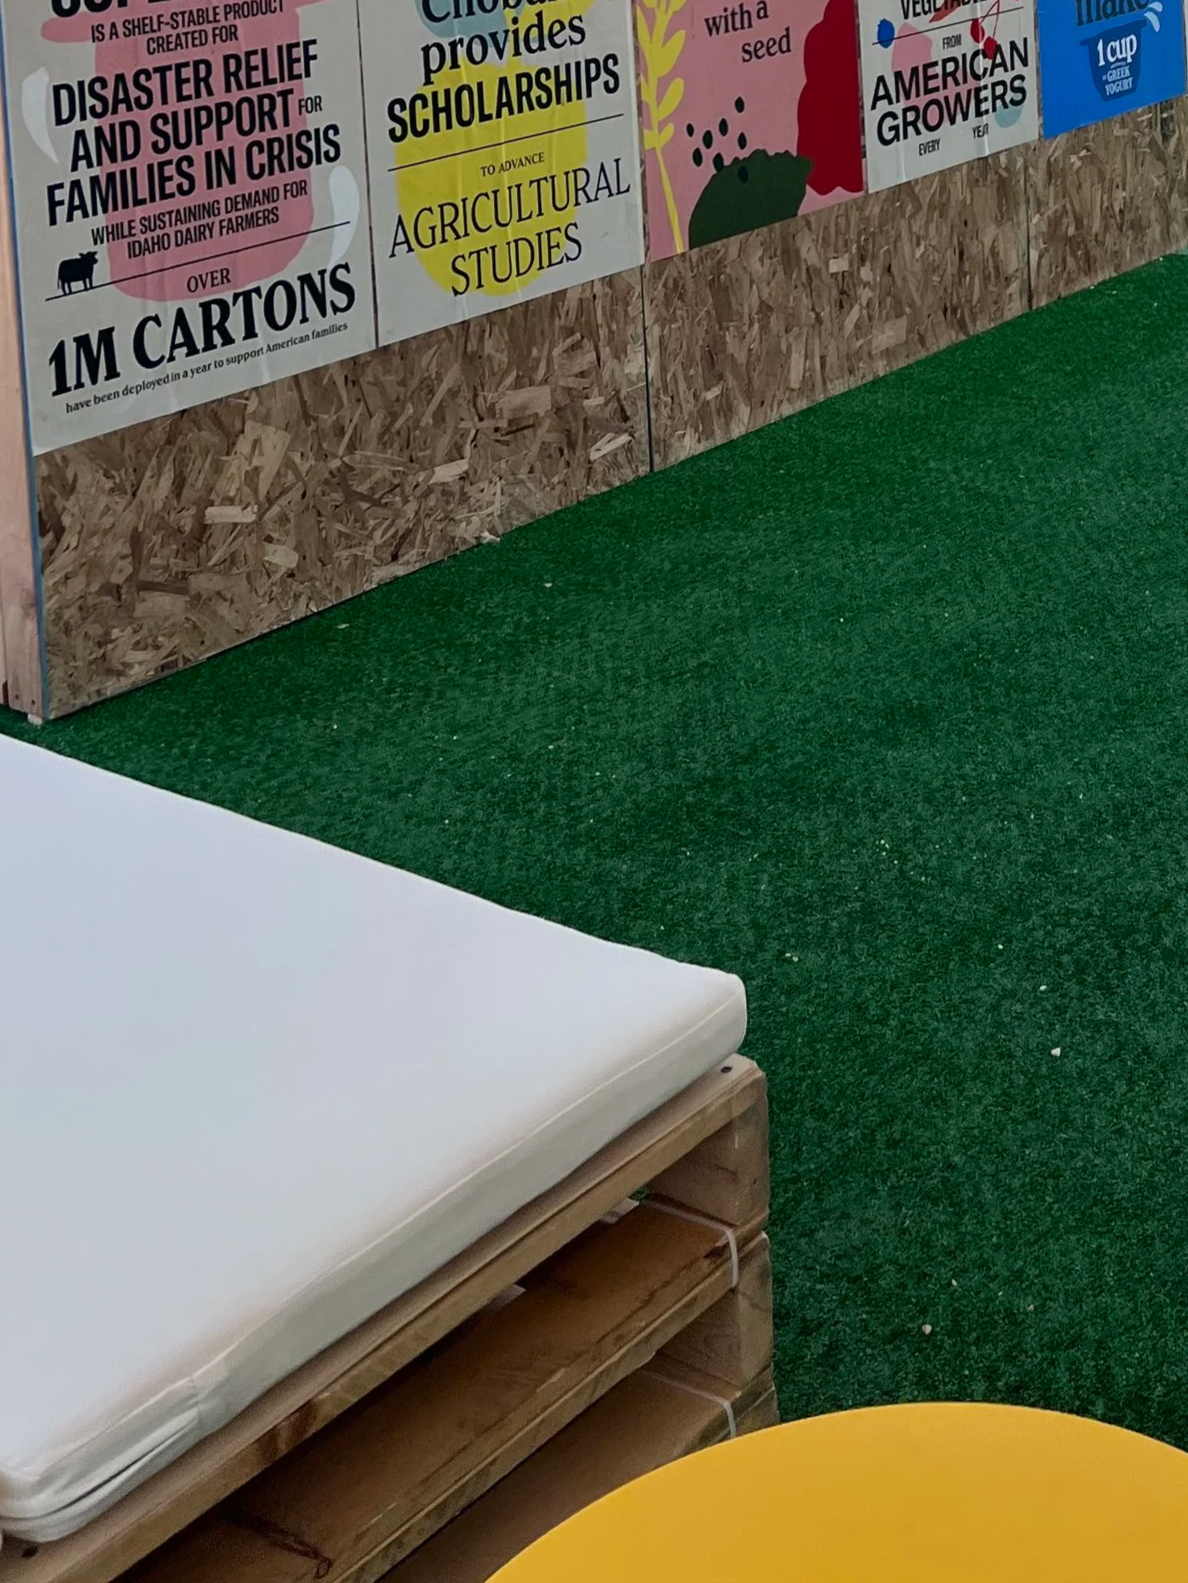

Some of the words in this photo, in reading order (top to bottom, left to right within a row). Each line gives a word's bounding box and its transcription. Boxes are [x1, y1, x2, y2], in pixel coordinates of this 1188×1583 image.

[741, 27, 791, 63] seed
[1097, 39, 1105, 66] 1
[1107, 34, 1137, 63] cup
[52, 58, 214, 127] DISASTER
[223, 39, 318, 93] RELIEF
[1105, 77, 1133, 95] YOGURT
[1107, 66, 1130, 82] GREEK
[387, 53, 620, 143] SCHOLARSHIPS
[480, 164, 495, 177] TO
[498, 152, 545, 174] ADVANCE
[186, 268, 231, 294] OVER
[49, 326, 121, 397] 1M
[132, 262, 356, 369] CARTONS
[66, 397, 92, 414] have
[93, 389, 120, 405] been
[122, 374, 170, 397] deployed
[171, 371, 181, 381] in
[182, 369, 189, 378] a
[190, 361, 212, 379] year
[214, 359, 224, 369] to
[226, 347, 264, 366] support
[266, 333, 310, 353] American
[311, 322, 348, 339] families
